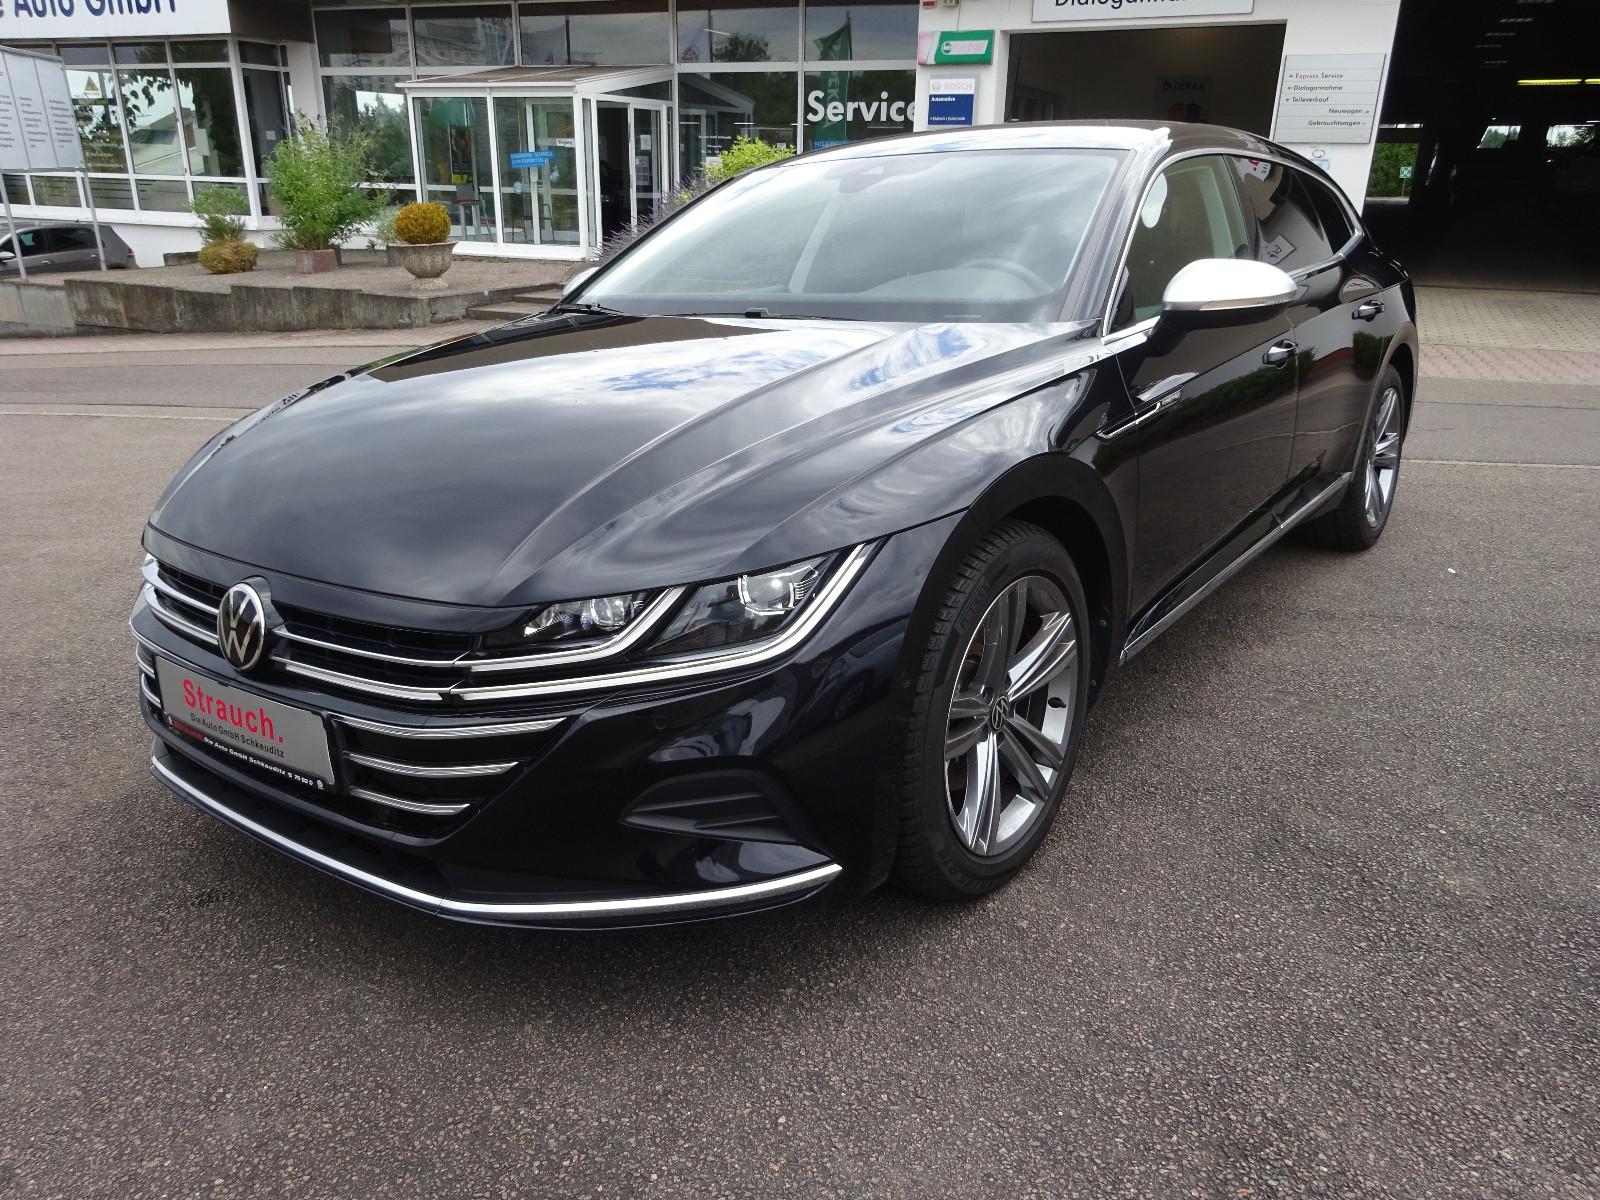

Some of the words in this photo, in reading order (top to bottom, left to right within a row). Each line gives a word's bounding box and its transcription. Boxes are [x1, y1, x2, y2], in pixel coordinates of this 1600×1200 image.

[183, 678, 283, 743] Strauch.
[202, 718, 217, 732] Auto
[219, 725, 240, 741] GmbH
[241, 734, 285, 758] Schkeuditz
[214, 742, 228, 752] Auto
[229, 748, 248, 760] GmbH
[248, 756, 286, 775] Schkeuditz
